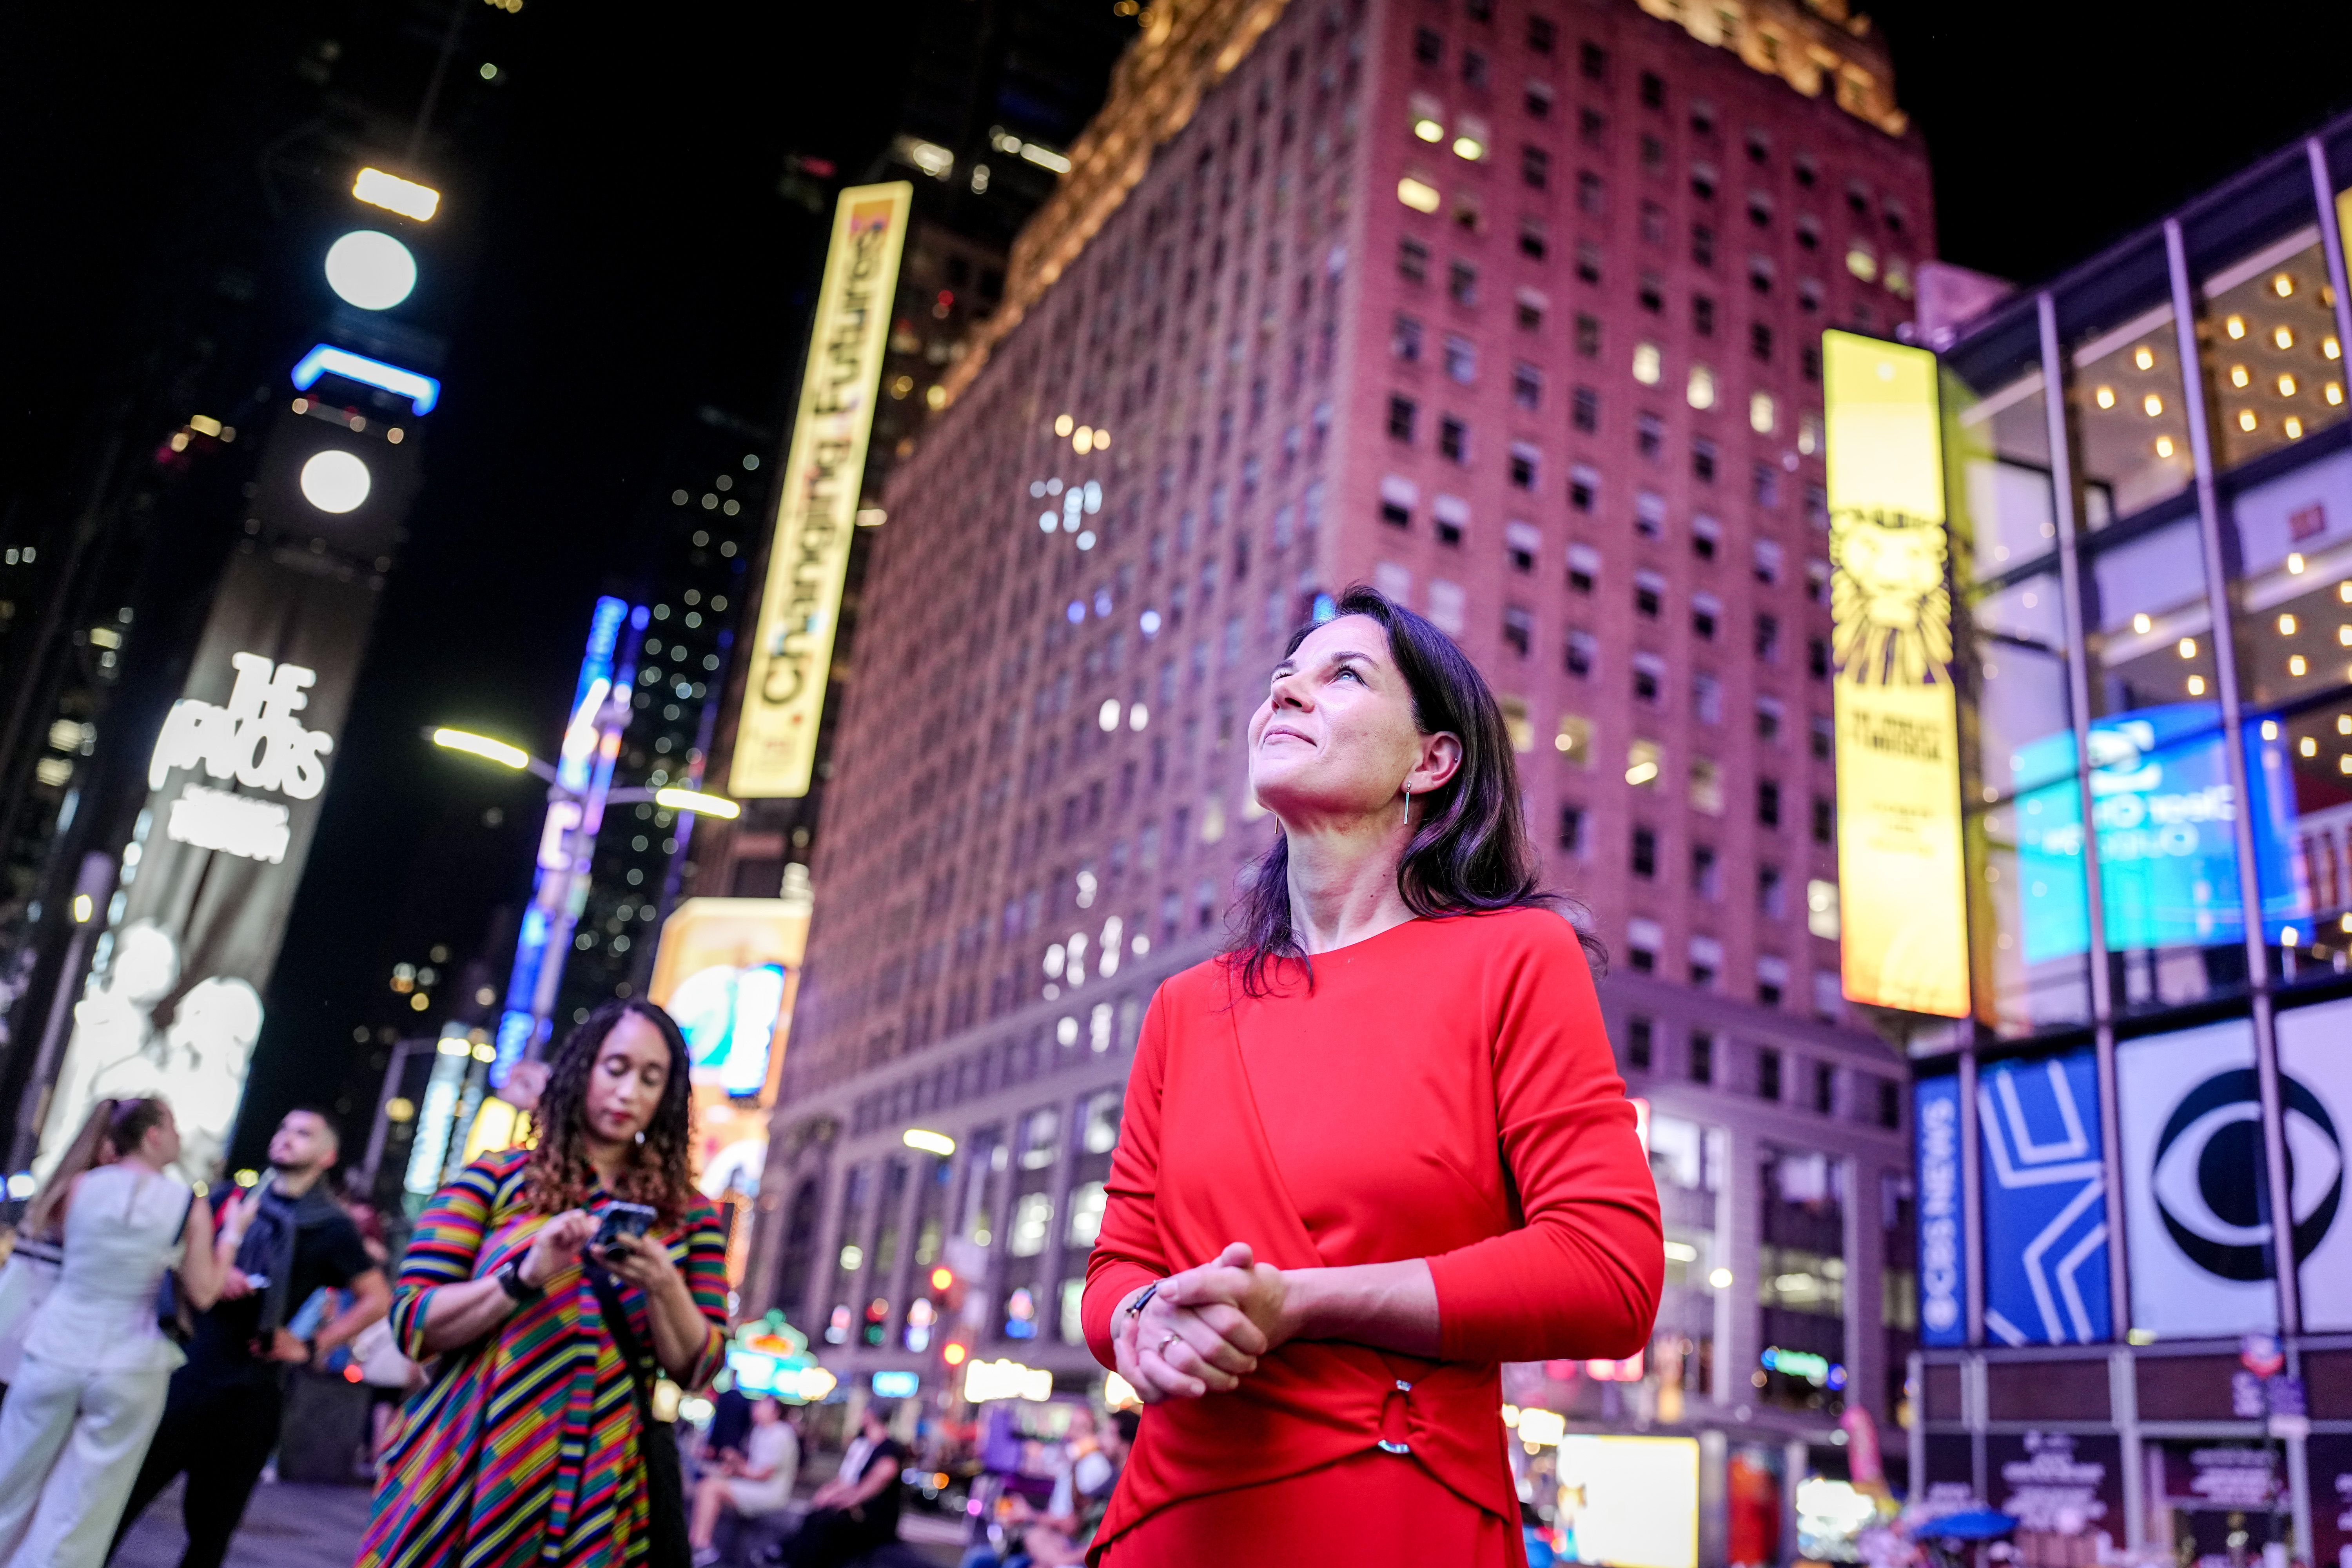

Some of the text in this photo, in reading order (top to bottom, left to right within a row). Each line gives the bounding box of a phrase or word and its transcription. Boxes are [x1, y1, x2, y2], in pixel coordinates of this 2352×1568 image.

[760, 435, 854, 705] Changing
[814, 223, 885, 415] Futures
[232, 652, 316, 719] THE
[1922, 1098, 1956, 1297] CBS NEWS
